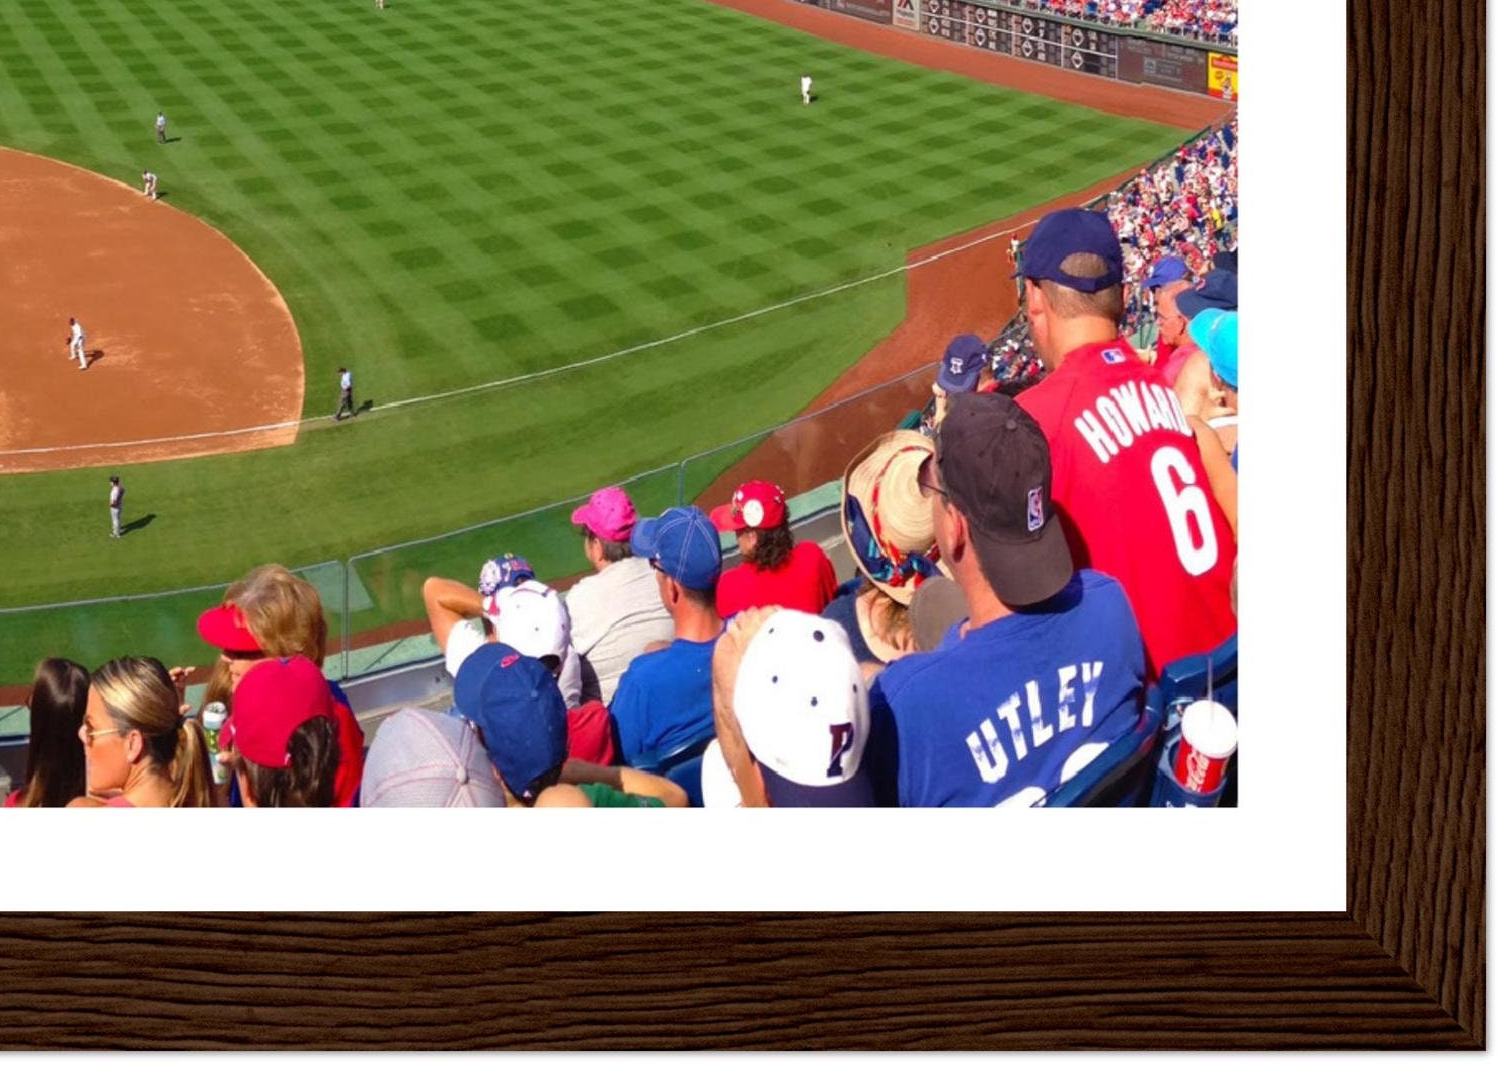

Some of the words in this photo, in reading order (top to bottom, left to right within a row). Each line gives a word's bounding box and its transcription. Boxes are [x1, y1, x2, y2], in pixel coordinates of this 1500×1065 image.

[1074, 380, 1194, 464] HOWARD
[1150, 446, 1218, 577] 6
[826, 722, 855, 778] P
[965, 661, 1104, 784] UTLEY
